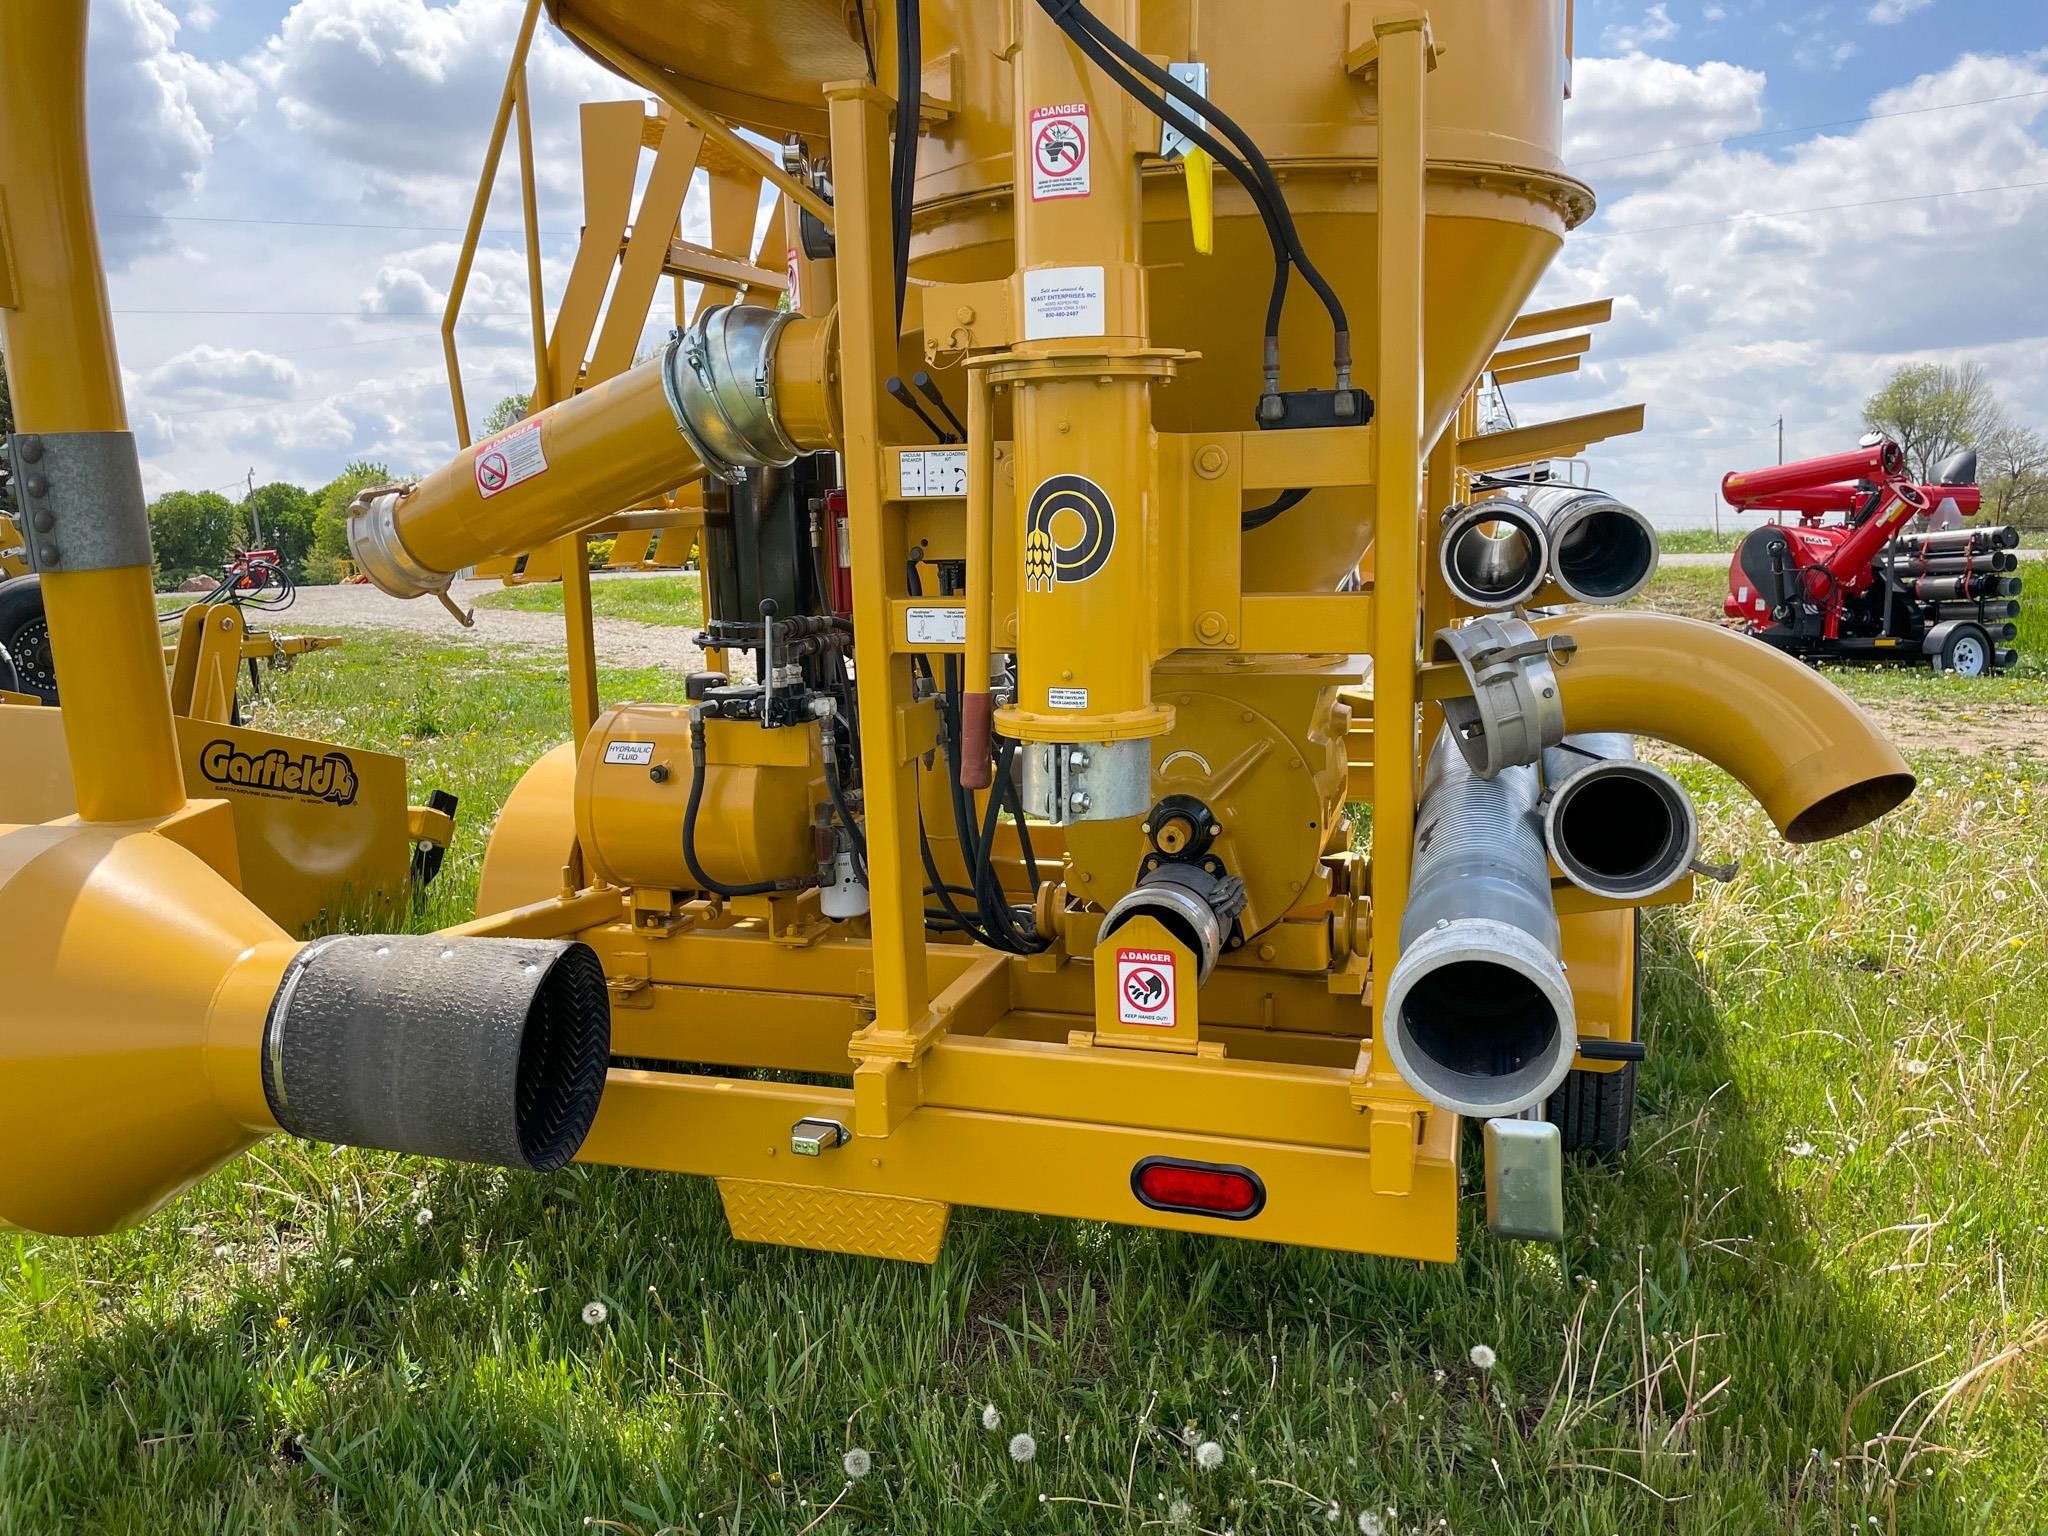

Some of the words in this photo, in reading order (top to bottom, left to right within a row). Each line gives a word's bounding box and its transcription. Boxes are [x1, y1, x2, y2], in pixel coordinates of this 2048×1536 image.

[1041, 104, 1086, 117] DANGER
[1047, 293, 1086, 301] ENTERPRISES
[493, 423, 535, 449] DANGER
[609, 745, 652, 753] HYDRAULIC
[201, 739, 335, 798] Garfield
[1128, 952, 1171, 962] DANGER
